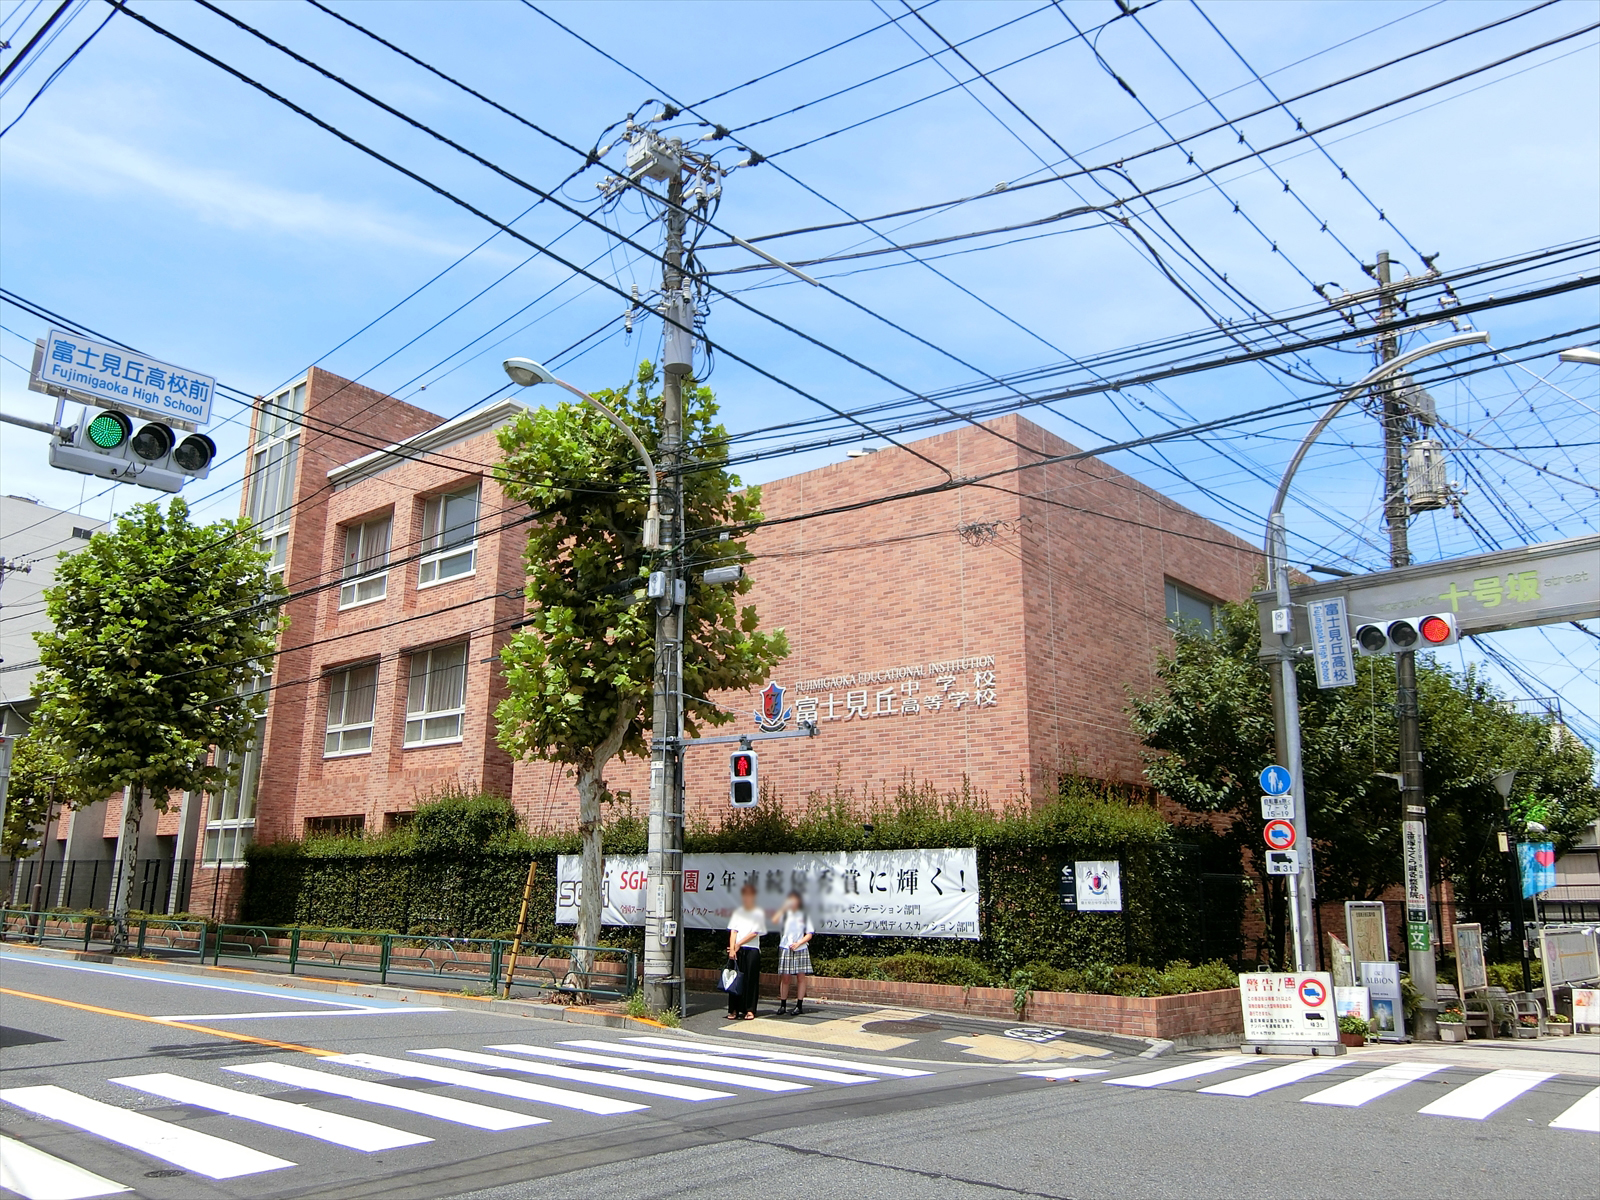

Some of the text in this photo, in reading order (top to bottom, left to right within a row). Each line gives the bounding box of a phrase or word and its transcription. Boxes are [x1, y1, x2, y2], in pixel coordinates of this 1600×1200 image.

[52, 339, 210, 403] 富士見丘高校前
[52, 364, 203, 417] Fujimigaoka High School
[1438, 570, 1541, 612] 十号坂
[1544, 571, 1589, 587] street
[1313, 605, 1331, 682] Fujimigaoka High School
[1324, 602, 1349, 682] 富士見丘高校
[795, 655, 996, 693] FUJIMIGAOKA EDUCATIONAL INSTITUTION
[901, 670, 996, 697] 中学校
[795, 686, 899, 723] 富士見丘
[901, 687, 998, 714] 高等学校
[620, 870, 648, 891] SGH
[685, 871, 699, 892] 園
[1410, 930, 1425, 946] 文
[1365, 977, 1394, 985] ALBION
